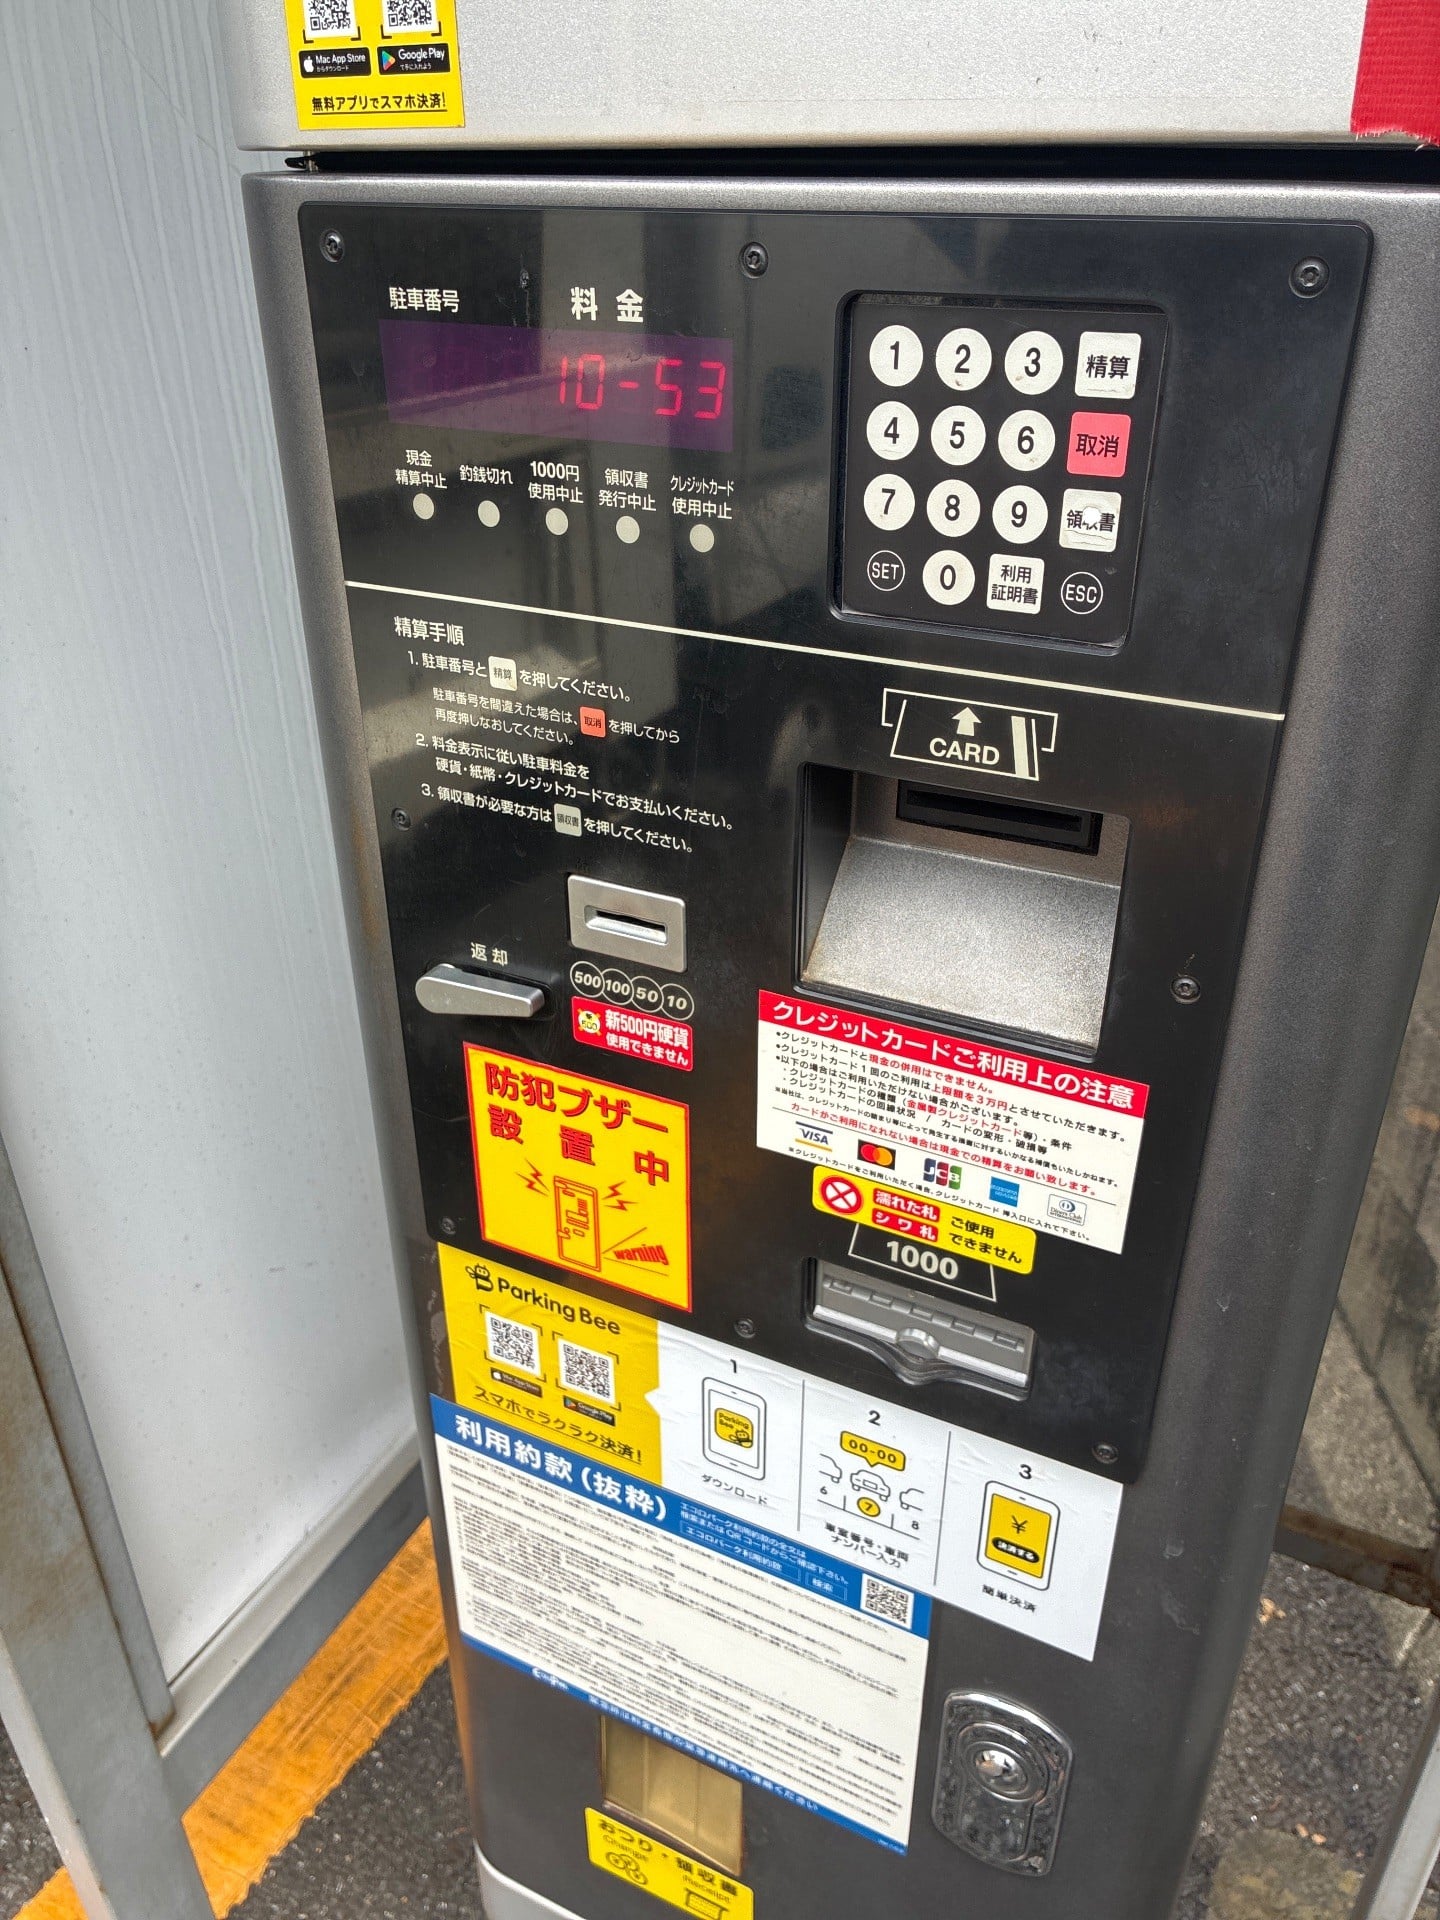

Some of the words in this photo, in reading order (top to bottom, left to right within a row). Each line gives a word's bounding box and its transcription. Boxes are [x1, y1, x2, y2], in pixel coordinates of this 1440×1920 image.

[316, 55, 331, 65] Mac
[332, 54, 346, 65] App
[347, 53, 366, 63] Store
[399, 48, 428, 61] Google
[429, 48, 445, 60] Play
[389, 287, 460, 313] 駐車番号
[571, 287, 644, 322] 料金
[890, 341, 900, 370] 1
[954, 344, 971, 373] 2
[1024, 347, 1040, 377] 3
[1085, 354, 1131, 379] 精算
[884, 417, 900, 444] 4
[950, 421, 965, 449] 5
[1017, 426, 1035, 454] 6
[406, 450, 432, 467] 現金
[1076, 433, 1119, 458] 取消
[395, 468, 448, 490] 精算中止
[459, 464, 514, 486] 釣銭切れ
[530, 460, 581, 482] 1000円
[604, 468, 649, 489] 領収書
[528, 482, 584, 504] 使用中止
[670, 475, 734, 497] クレジットカード
[598, 489, 657, 512] 発行中止
[671, 497, 733, 520] 使用中止
[881, 488, 896, 515] 7
[944, 494, 960, 521] 8
[1011, 500, 1028, 528] 9
[872, 562, 900, 580] SET
[940, 565, 956, 591] 0
[1000, 564, 1032, 584] 利用
[991, 584, 1039, 606] 証明書
[1065, 584, 1098, 604] ESC
[394, 615, 465, 646] 精算手順
[408, 651, 419, 666] 1.
[422, 652, 488, 678] 駐車番号と
[493, 667, 513, 680] 精算
[519, 669, 631, 702] を押してください。
[433, 687, 578, 726] 駐車番号を間違えた場合は、
[584, 716, 602, 728] 取消
[608, 719, 680, 744] を押してから
[435, 707, 574, 746] 再度押しなおしてください。
[415, 733, 429, 748] 2.
[432, 735, 590, 780] 料金表示に従い駐車料金を
[929, 737, 1000, 766] CARD
[435, 756, 733, 830] 硬貨・紙幣・クレジットカードでお支払いください。
[421, 783, 434, 798] 3.
[437, 785, 553, 822] 領収書が必要な方は
[556, 813, 579, 828] 領収書
[584, 817, 692, 853] を押してください。
[470, 942, 508, 967] 返却
[574, 970, 602, 989] 500
[605, 979, 630, 996] 100
[635, 987, 659, 1003] 50
[667, 994, 687, 1011] 10
[605, 1009, 689, 1050] 新500円硬貨
[606, 1032, 689, 1066] 使用できません
[773, 1001, 1135, 1109] クレジットカードご利用上の注意
[781, 1031, 993, 1094] クレジットカードと現金の併用はできません。
[484, 1061, 669, 1133] 防犯ブザー
[781, 1055, 1018, 1127] 以下の場合はご利用いただけない場合がございます。
[488, 1103, 670, 1187] 設置中
[800, 1128, 829, 1145] VISA
[923, 1158, 962, 1190] JCB
[875, 1190, 938, 1221] 濡れた札
[875, 1213, 936, 1241] シワ札
[951, 1217, 995, 1240] ご使用
[613, 1243, 670, 1266] warning
[886, 1240, 959, 1280] 1000
[949, 1232, 1022, 1264] できません
[497, 1277, 576, 1322] Parking
[579, 1306, 621, 1335] Bee
[730, 1359, 737, 1373] 1
[869, 1410, 881, 1426] 2
[849, 1439, 897, 1464] 00-00
[455, 1414, 667, 1521] 利用約款（抜粋）
[1019, 1464, 1032, 1480] 3
[702, 1474, 768, 1505] ダウンロード
[820, 1486, 828, 1495] 6
[864, 1501, 873, 1511] 7
[911, 1520, 920, 1530] 8
[831, 1535, 901, 1568] ナンバー入力
[982, 1584, 1037, 1613] 簡単決済
